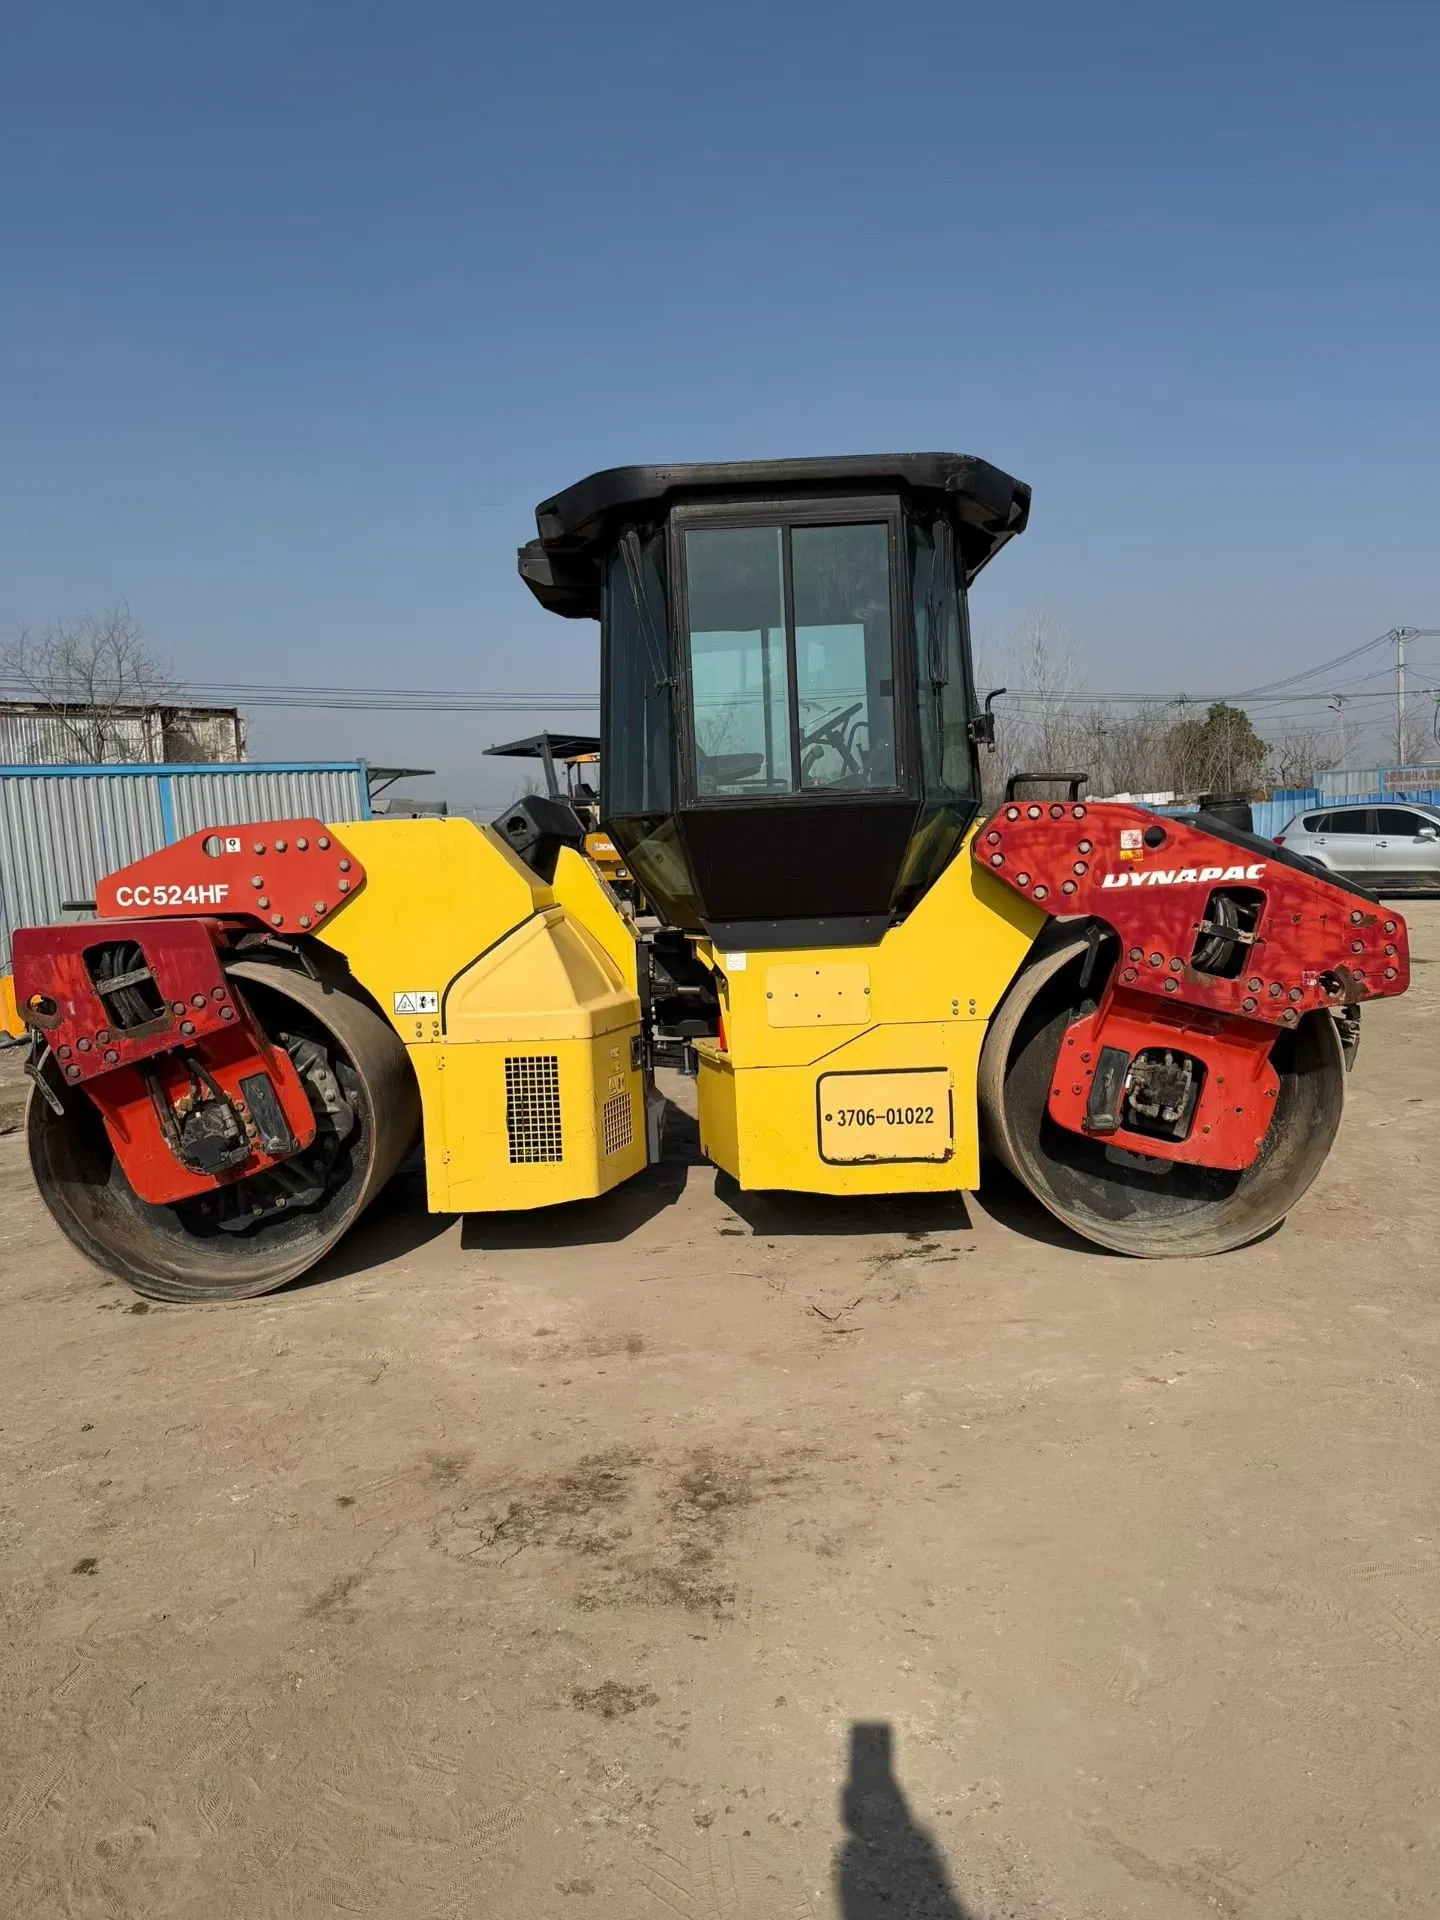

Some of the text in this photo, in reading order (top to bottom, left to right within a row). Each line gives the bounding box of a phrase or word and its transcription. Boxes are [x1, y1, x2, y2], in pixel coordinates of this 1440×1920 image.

[1101, 863, 1267, 888] DYNAPAC
[116, 884, 229, 907] CC524HF
[837, 1107, 934, 1127] 3706-01022
